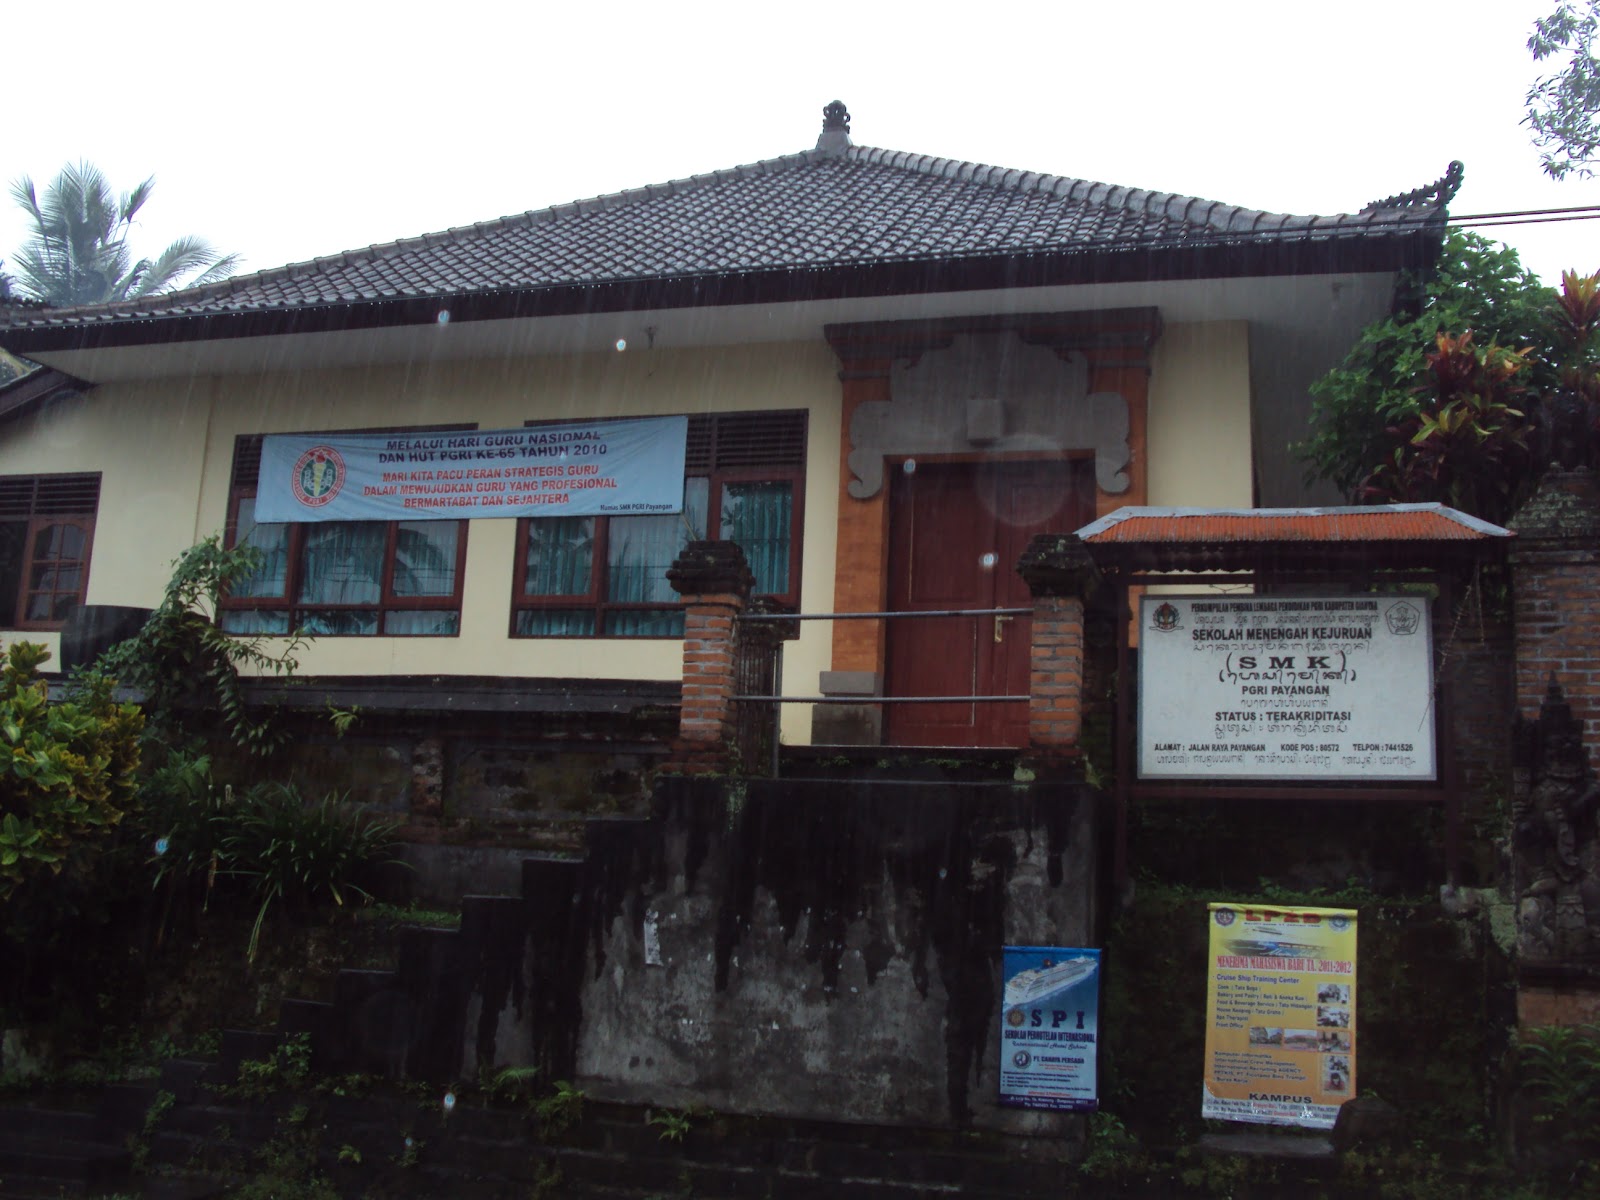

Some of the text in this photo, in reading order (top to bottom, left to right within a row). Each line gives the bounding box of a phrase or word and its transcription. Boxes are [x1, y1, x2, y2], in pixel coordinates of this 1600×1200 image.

[387, 431, 600, 450] MELALUI HARI GURU NASIONAL
[379, 444, 607, 463] DAN HUT PGRI KE-65 TAHUN 2010
[383, 465, 599, 482] MARI KITA PACU PERAN STRATEGIS GURU
[364, 478, 617, 496] DALAM MEWUJUDKAN GURU YANG PROFESIONAL
[404, 493, 569, 508] BERMARTABAT DAN SEJAHTERA
[646, 503, 672, 511] Payangan
[1192, 627, 1372, 640] SEKOLAH MENENGAH KEJURUAN
[1242, 685, 1330, 695] PGRI PAYANGAN
[1215, 712, 1257, 721] STATUS
[1266, 711, 1351, 721] TERAKRIDITASI
[1154, 743, 1181, 751] ALAMAT
[1188, 743, 1210, 752] JALAN
[1211, 743, 1229, 752] RAYA
[1230, 743, 1266, 752] PAYANGAN
[1280, 743, 1299, 752] KODE
[1300, 743, 1314, 752] POS
[1319, 743, 1340, 752] 80572
[1352, 743, 1380, 751] TELPON
[1385, 743, 1413, 751] 7441526
[1216, 955, 1248, 969] MENERIMA
[1250, 956, 1286, 970] MAHASISWA
[1287, 957, 1305, 971] BARU
[1318, 960, 1352, 973] 2011-2012
[1237, 974, 1251, 983] Ship
[1253, 975, 1277, 984] Training
[1279, 976, 1300, 984] Center
[1249, 1093, 1313, 1104] KAMPUS
